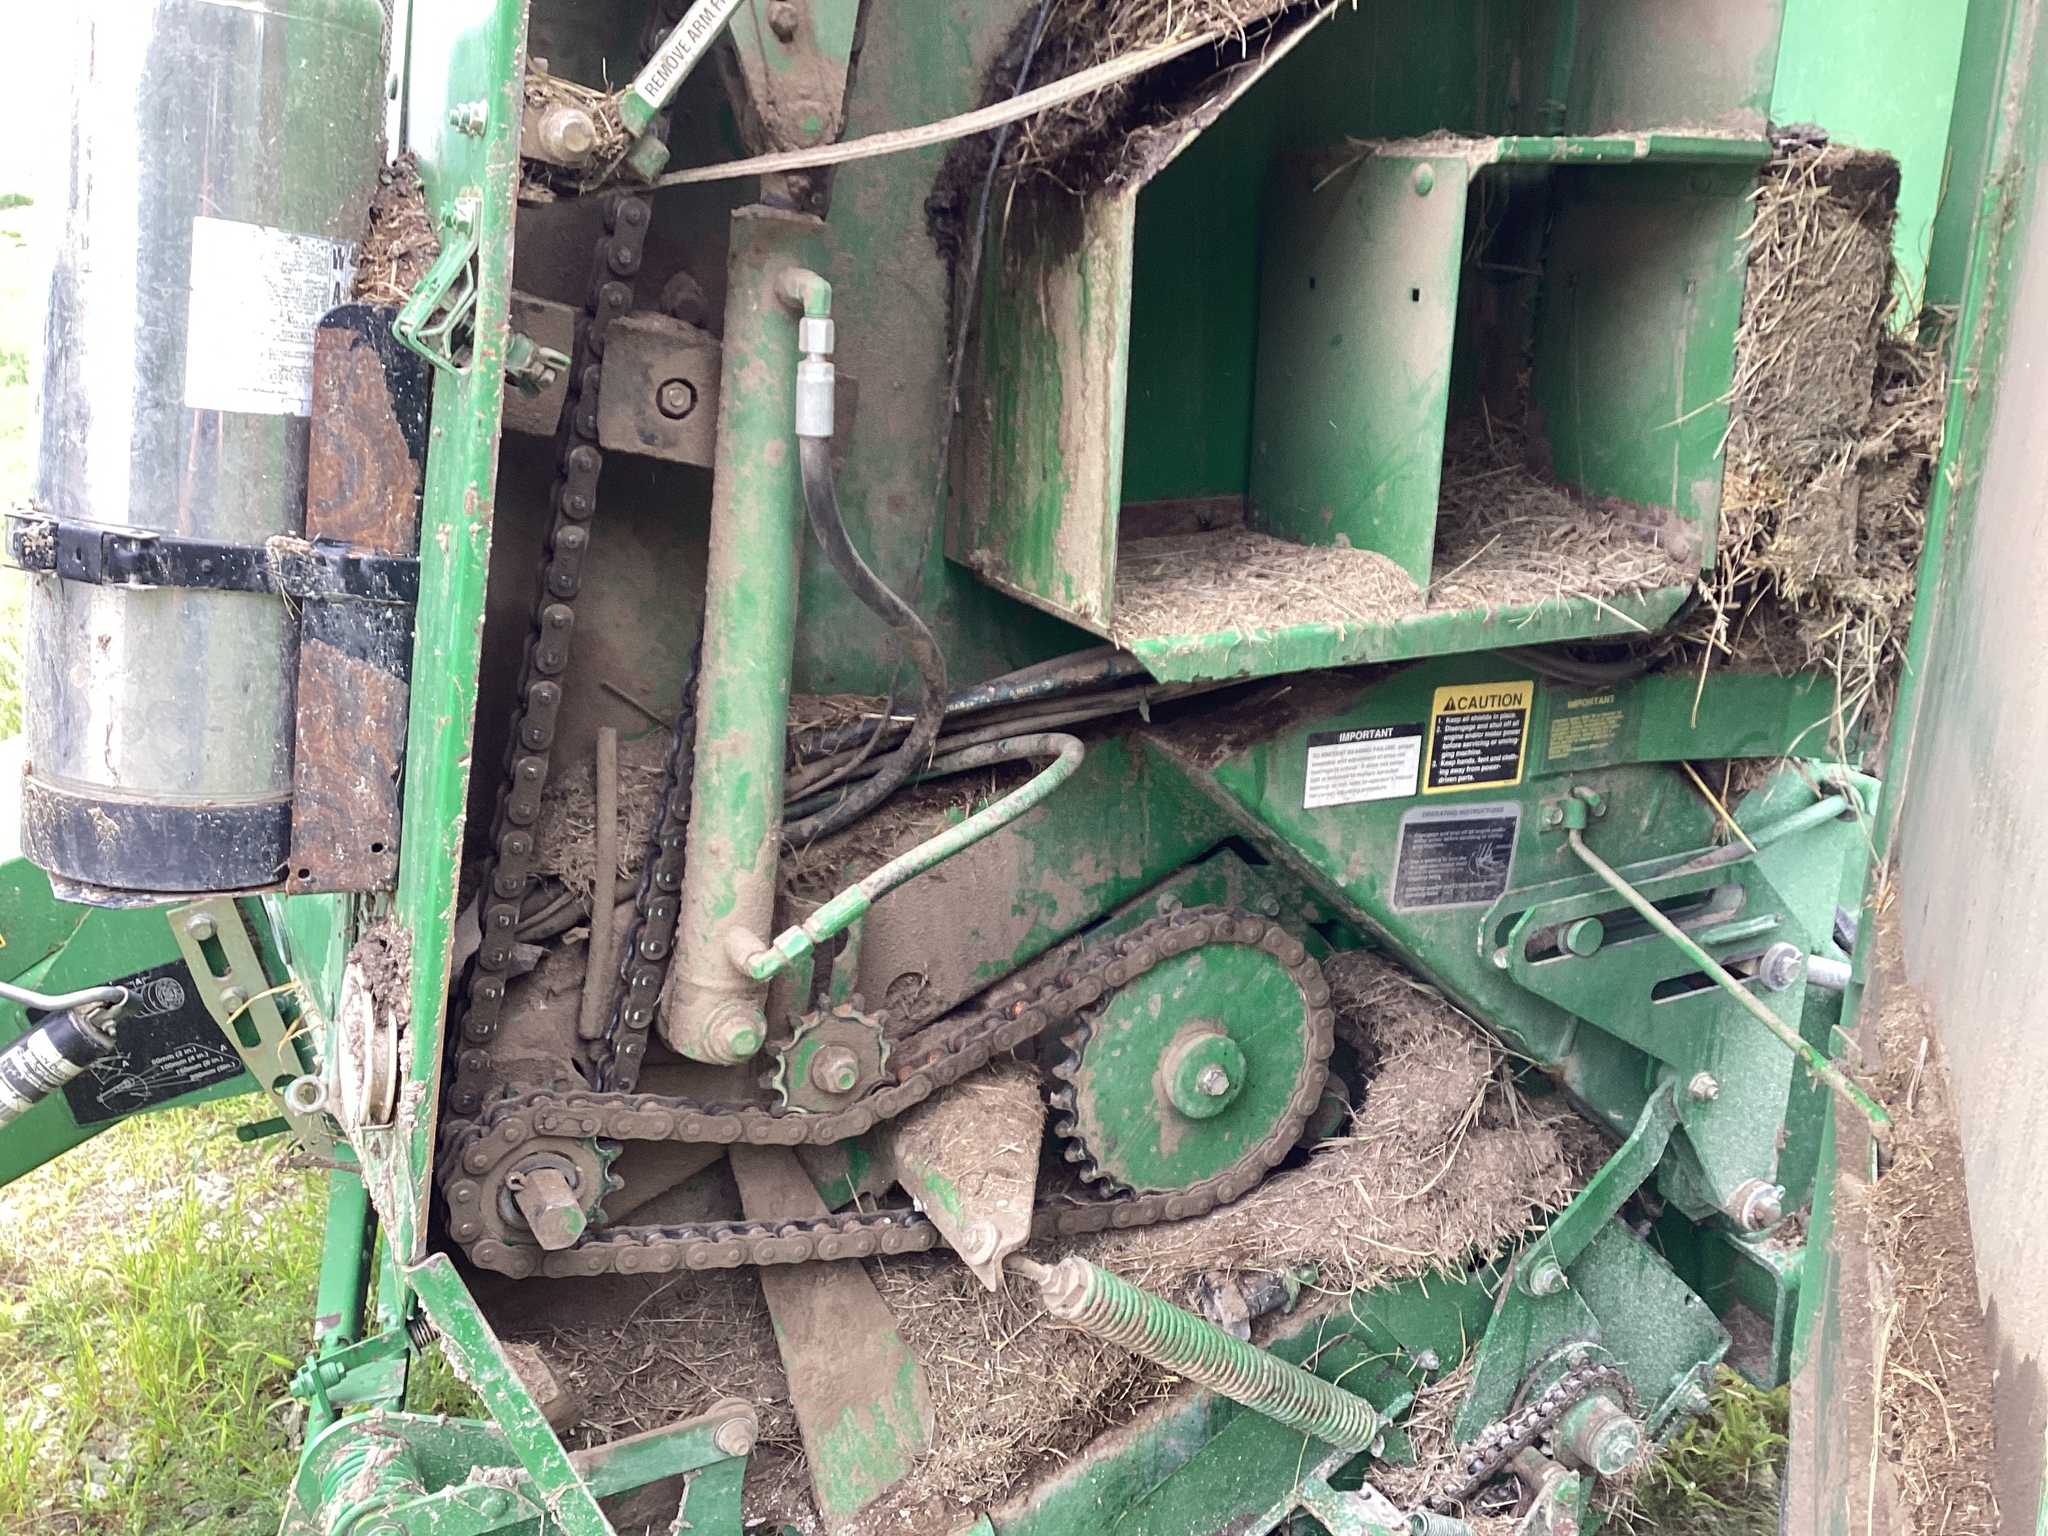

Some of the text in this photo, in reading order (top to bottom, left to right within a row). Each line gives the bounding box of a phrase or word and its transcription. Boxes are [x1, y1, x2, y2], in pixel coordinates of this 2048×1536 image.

[645, 39, 692, 97] REMOVE
[687, 7, 717, 43] ARM
[1458, 693, 1522, 710] CAUTION
[1567, 695, 1615, 709] IMPORTANT
[1500, 712, 1516, 720] place.
[1445, 724, 1476, 733] Disengage
[1339, 728, 1394, 742] IMPORTANT
[1444, 734, 1464, 742] engine
[1503, 728, 1521, 736] power
[1442, 742, 1462, 750] before
[1463, 740, 1490, 748] servicing
[1456, 749, 1482, 757] machine.
[1441, 759, 1456, 767] Keep
[1438, 775, 1475, 784] driven parts.
[1422, 807, 1504, 818] OPERATING INSTRUCTIONS
[220, 1044, 227, 1052] A
[122, 1060, 130, 1068] A
[160, 1058, 187, 1071] 100mm
